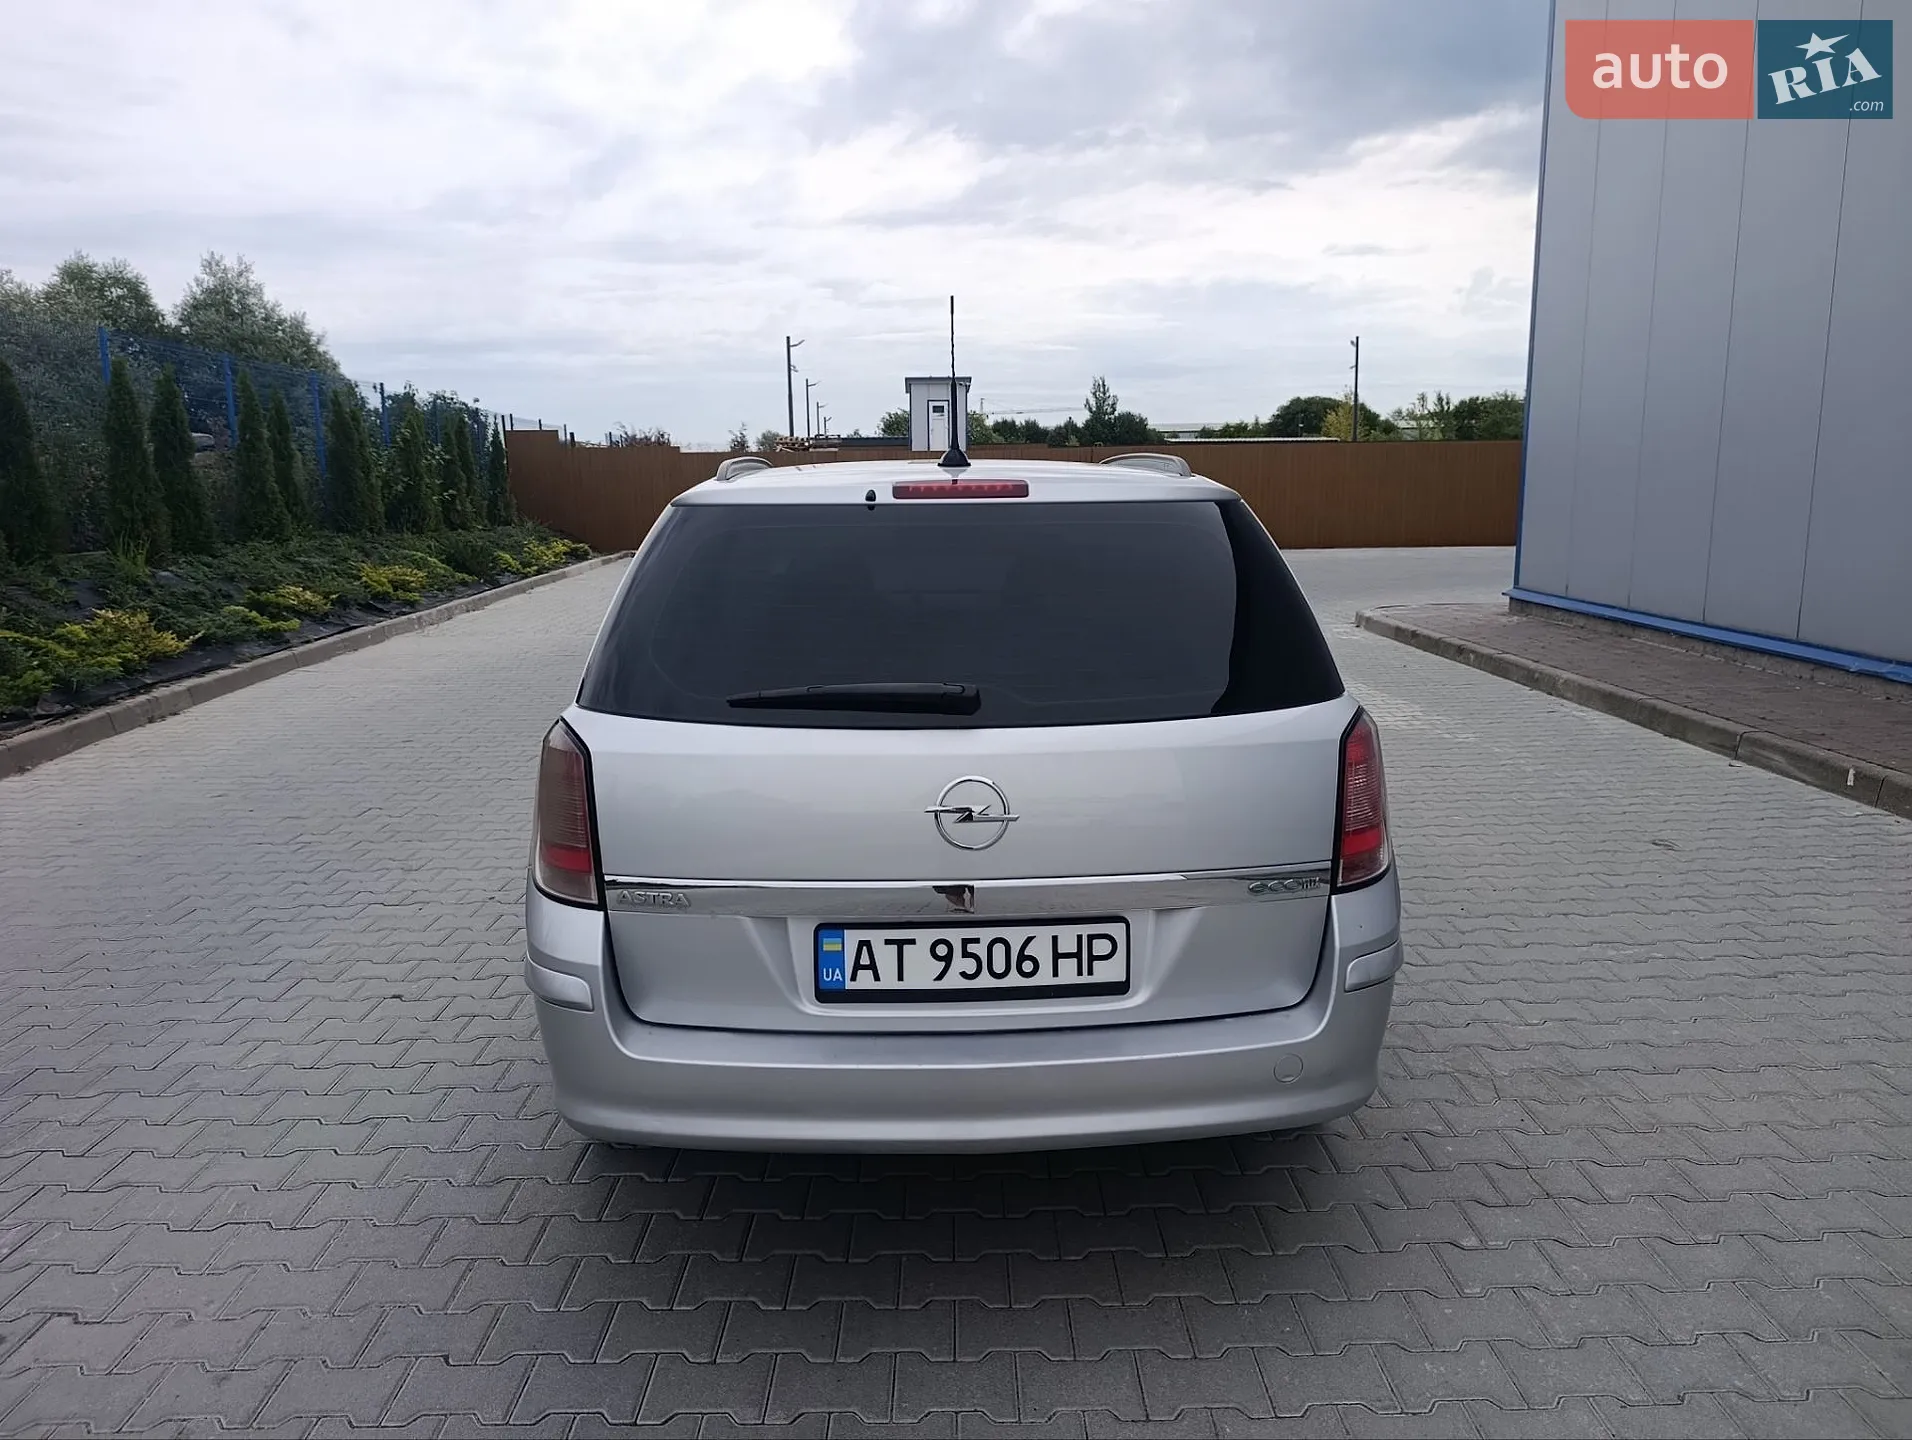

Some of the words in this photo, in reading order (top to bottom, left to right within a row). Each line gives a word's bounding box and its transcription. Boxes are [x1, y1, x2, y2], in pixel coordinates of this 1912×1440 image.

[618, 889, 691, 907] ASTRA
[850, 938, 917, 982] AT
[929, 934, 1041, 981] 9506
[1051, 932, 1118, 977] HP
[823, 968, 843, 981] UA
